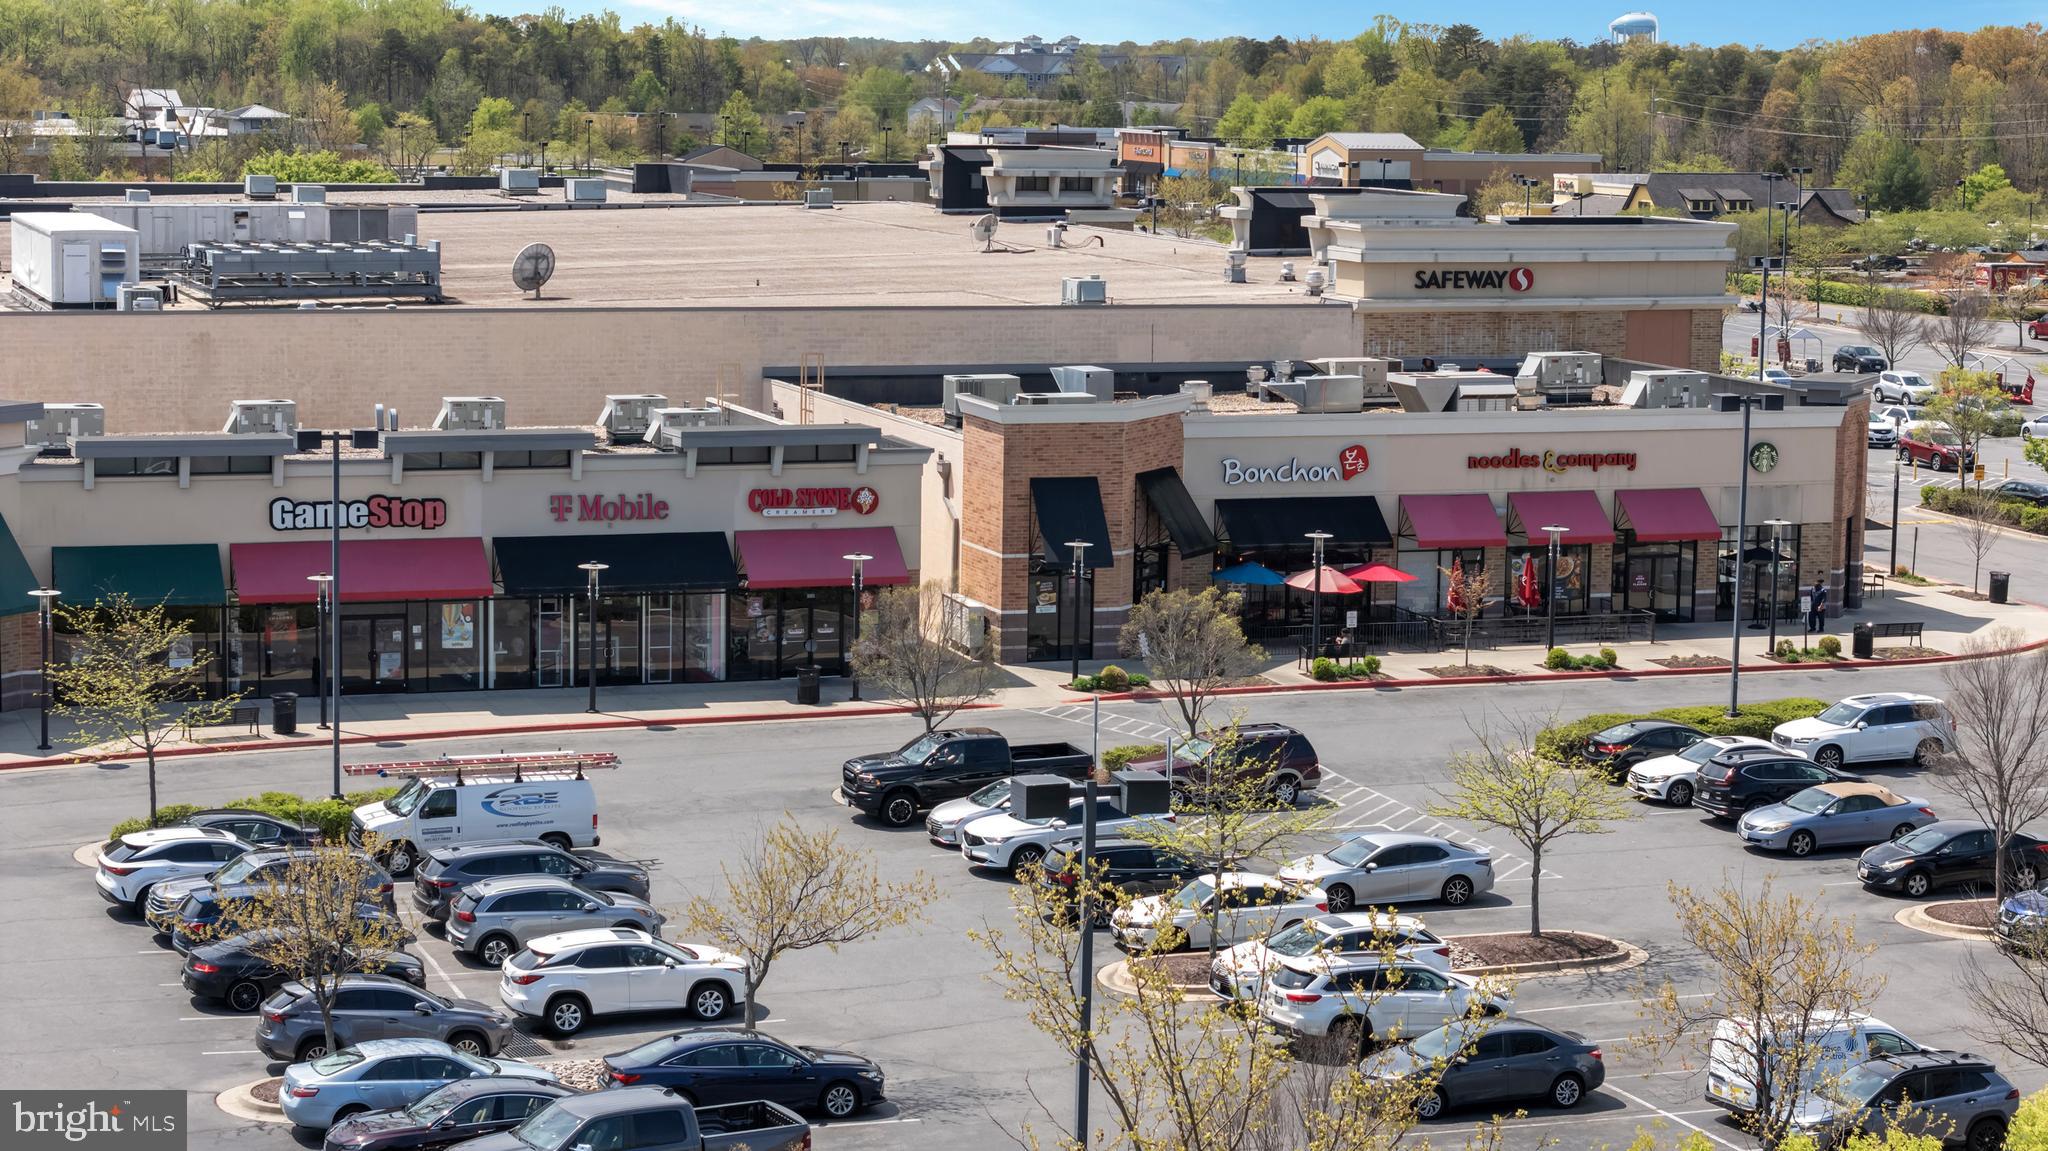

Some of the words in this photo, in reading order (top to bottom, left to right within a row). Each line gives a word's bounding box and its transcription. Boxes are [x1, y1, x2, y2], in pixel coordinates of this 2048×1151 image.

[1414, 270, 1509, 289] SAFEWAY
[1221, 457, 1340, 485] Bonchon
[1467, 448, 1540, 469] noodles
[1542, 449, 1567, 474] &
[1556, 451, 1637, 472] company
[270, 494, 446, 530] GameStop
[748, 488, 793, 512] COLD
[795, 487, 852, 511] STONE
[766, 508, 835, 516] CREAMERY
